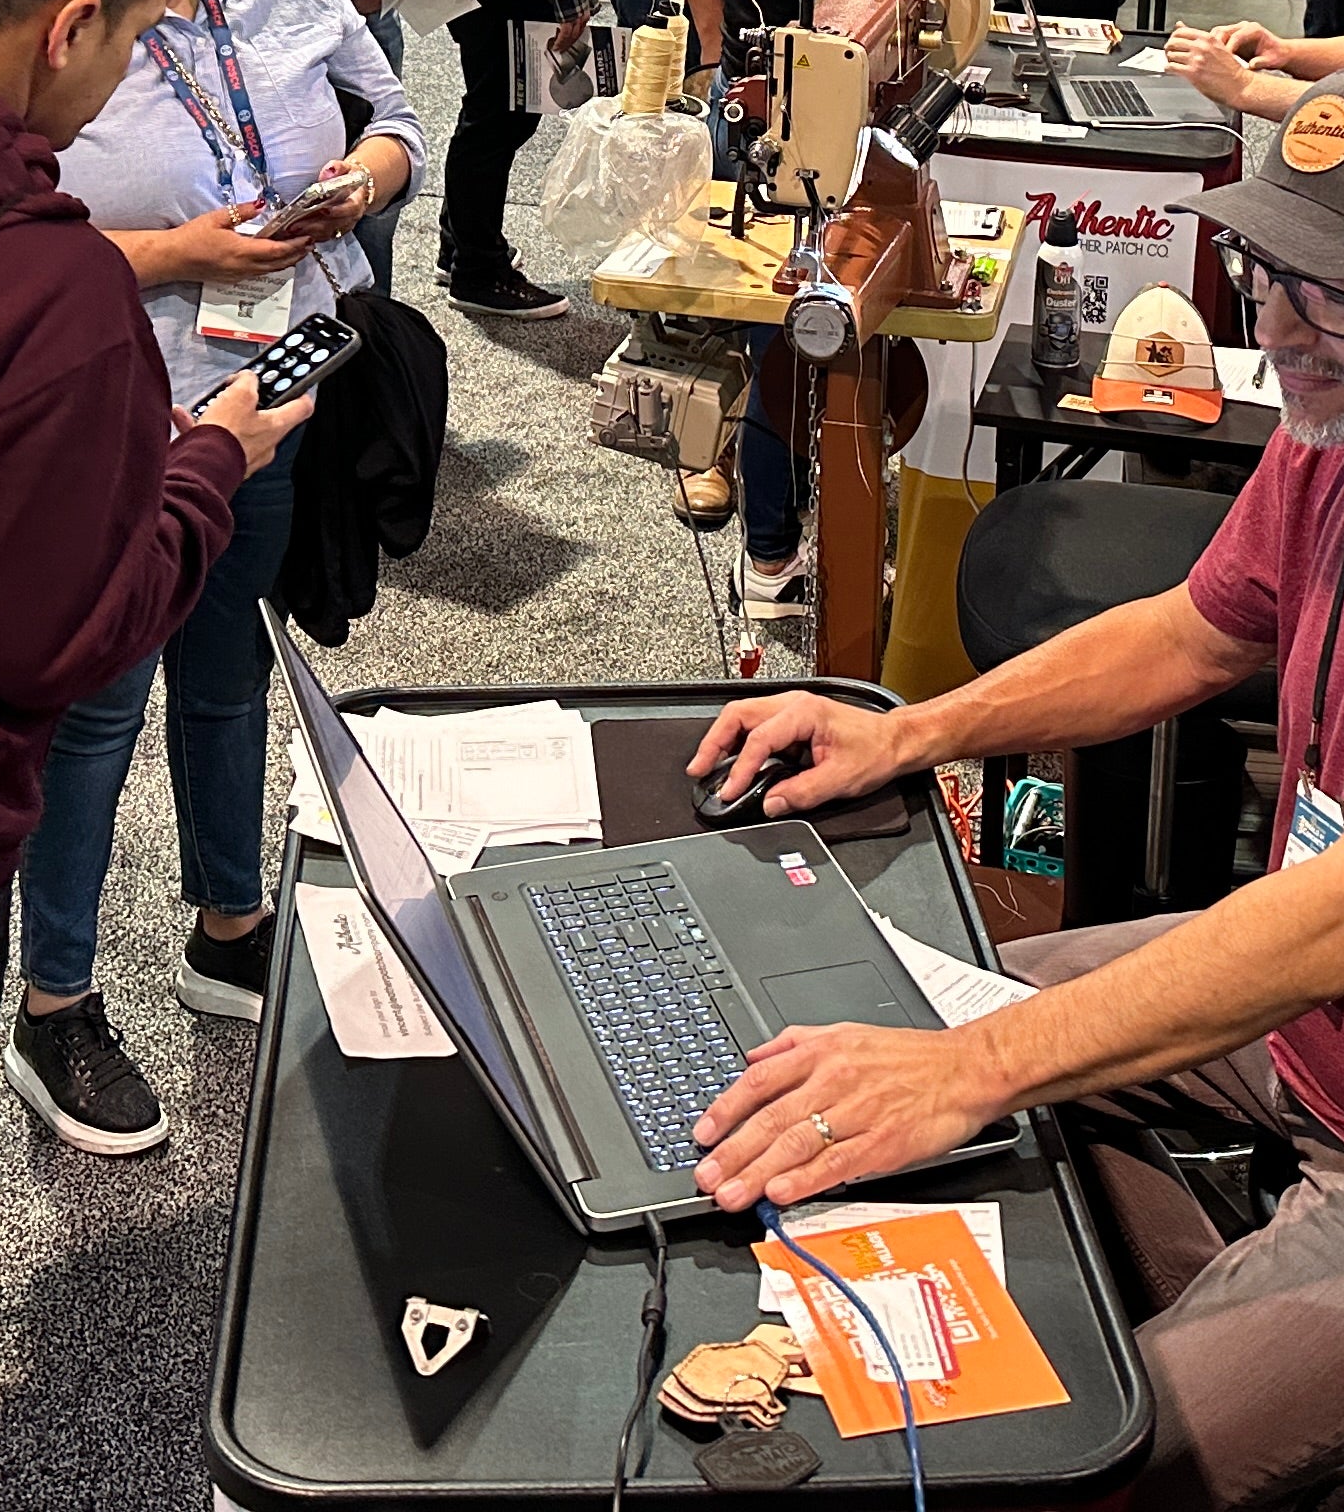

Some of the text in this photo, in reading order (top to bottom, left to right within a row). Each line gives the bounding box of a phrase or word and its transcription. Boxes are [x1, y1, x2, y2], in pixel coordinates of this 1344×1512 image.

[225, 58, 241, 90] BOSCH
[244, 124, 261, 157] BOSCH
[1025, 191, 1175, 242] Athentic
[1106, 241, 1143, 256] PATCH
[1045, 296, 1077, 307] Duster
